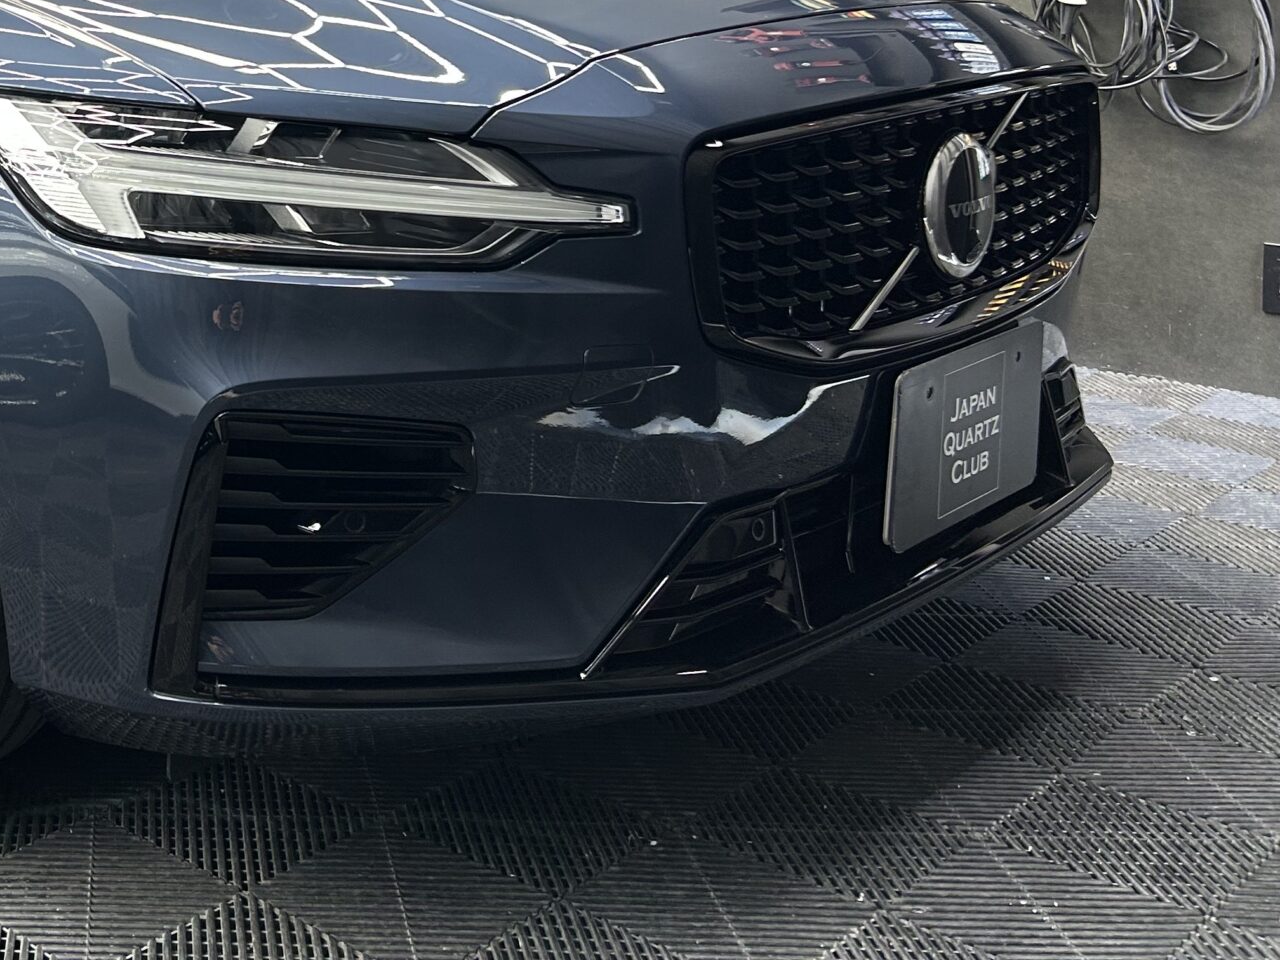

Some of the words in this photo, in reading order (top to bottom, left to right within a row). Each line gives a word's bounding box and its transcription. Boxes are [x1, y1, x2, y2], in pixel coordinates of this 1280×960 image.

[950, 386, 996, 423] JAPAN
[943, 414, 1000, 457] QUARTZ
[951, 450, 989, 484] CLUB
